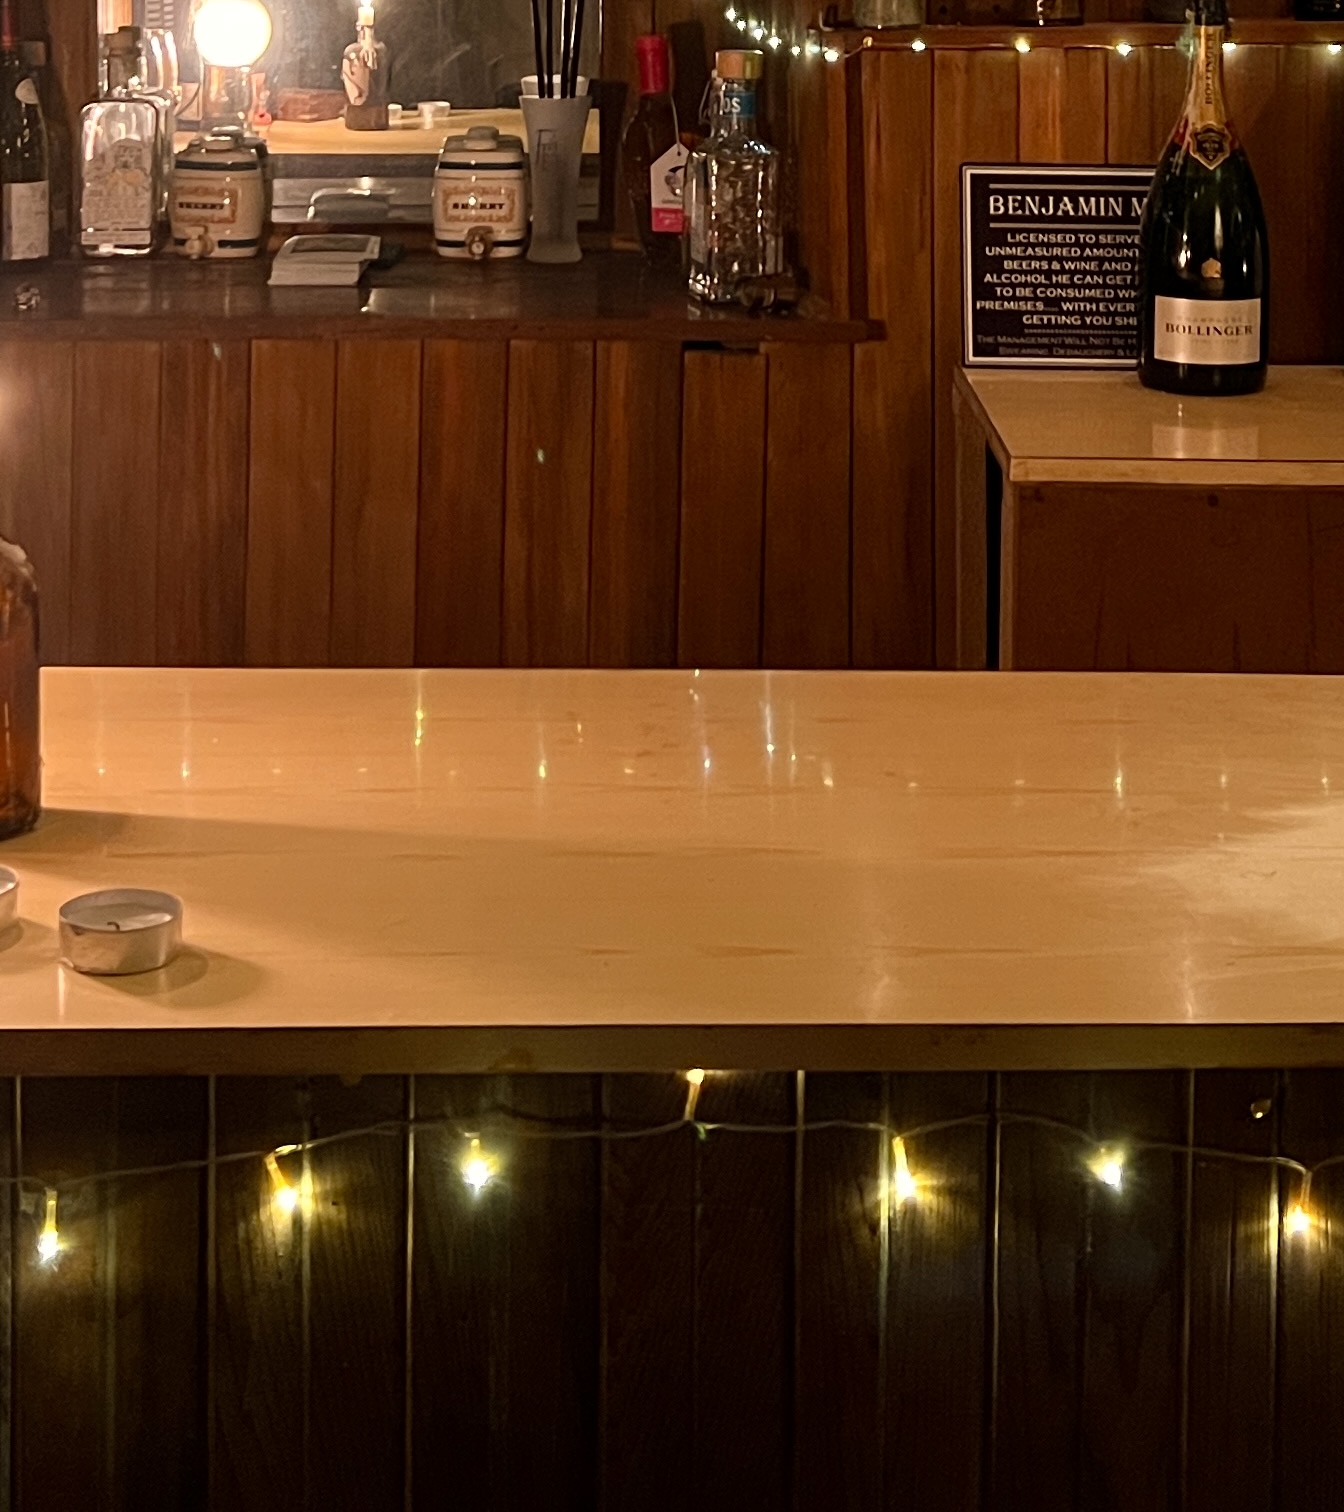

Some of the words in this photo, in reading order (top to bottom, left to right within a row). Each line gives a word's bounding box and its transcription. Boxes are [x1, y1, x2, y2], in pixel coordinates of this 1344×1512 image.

[989, 194, 1123, 217] BENJAMIN
[1130, 196, 1148, 217] M
[1007, 232, 1076, 244] LICENSED
[1077, 233, 1096, 244] TO
[985, 245, 1081, 258] UNMEASURED
[1082, 246, 1140, 258] AMOUNT
[1003, 259, 1049, 271] BEERS
[1050, 259, 1061, 271] &
[1062, 259, 1100, 272] WINE
[1101, 260, 1132, 272] AND
[983, 272, 1051, 285] ALCOHOL
[1051, 273, 1072, 285] HE
[1073, 273, 1104, 285] CAN
[1105, 274, 1133, 286] GET
[994, 286, 1014, 298] TO
[1015, 286, 1035, 298] BE
[1036, 287, 1116, 299] CONSUMED
[1060, 300, 1097, 313] WITH
[1098, 301, 1136, 313] EVER
[1022, 314, 1082, 326] GETTING
[1083, 315, 1113, 326] YOU
[1114, 316, 1138, 326] SHI
[1164, 322, 1254, 337] BOLLINGER
